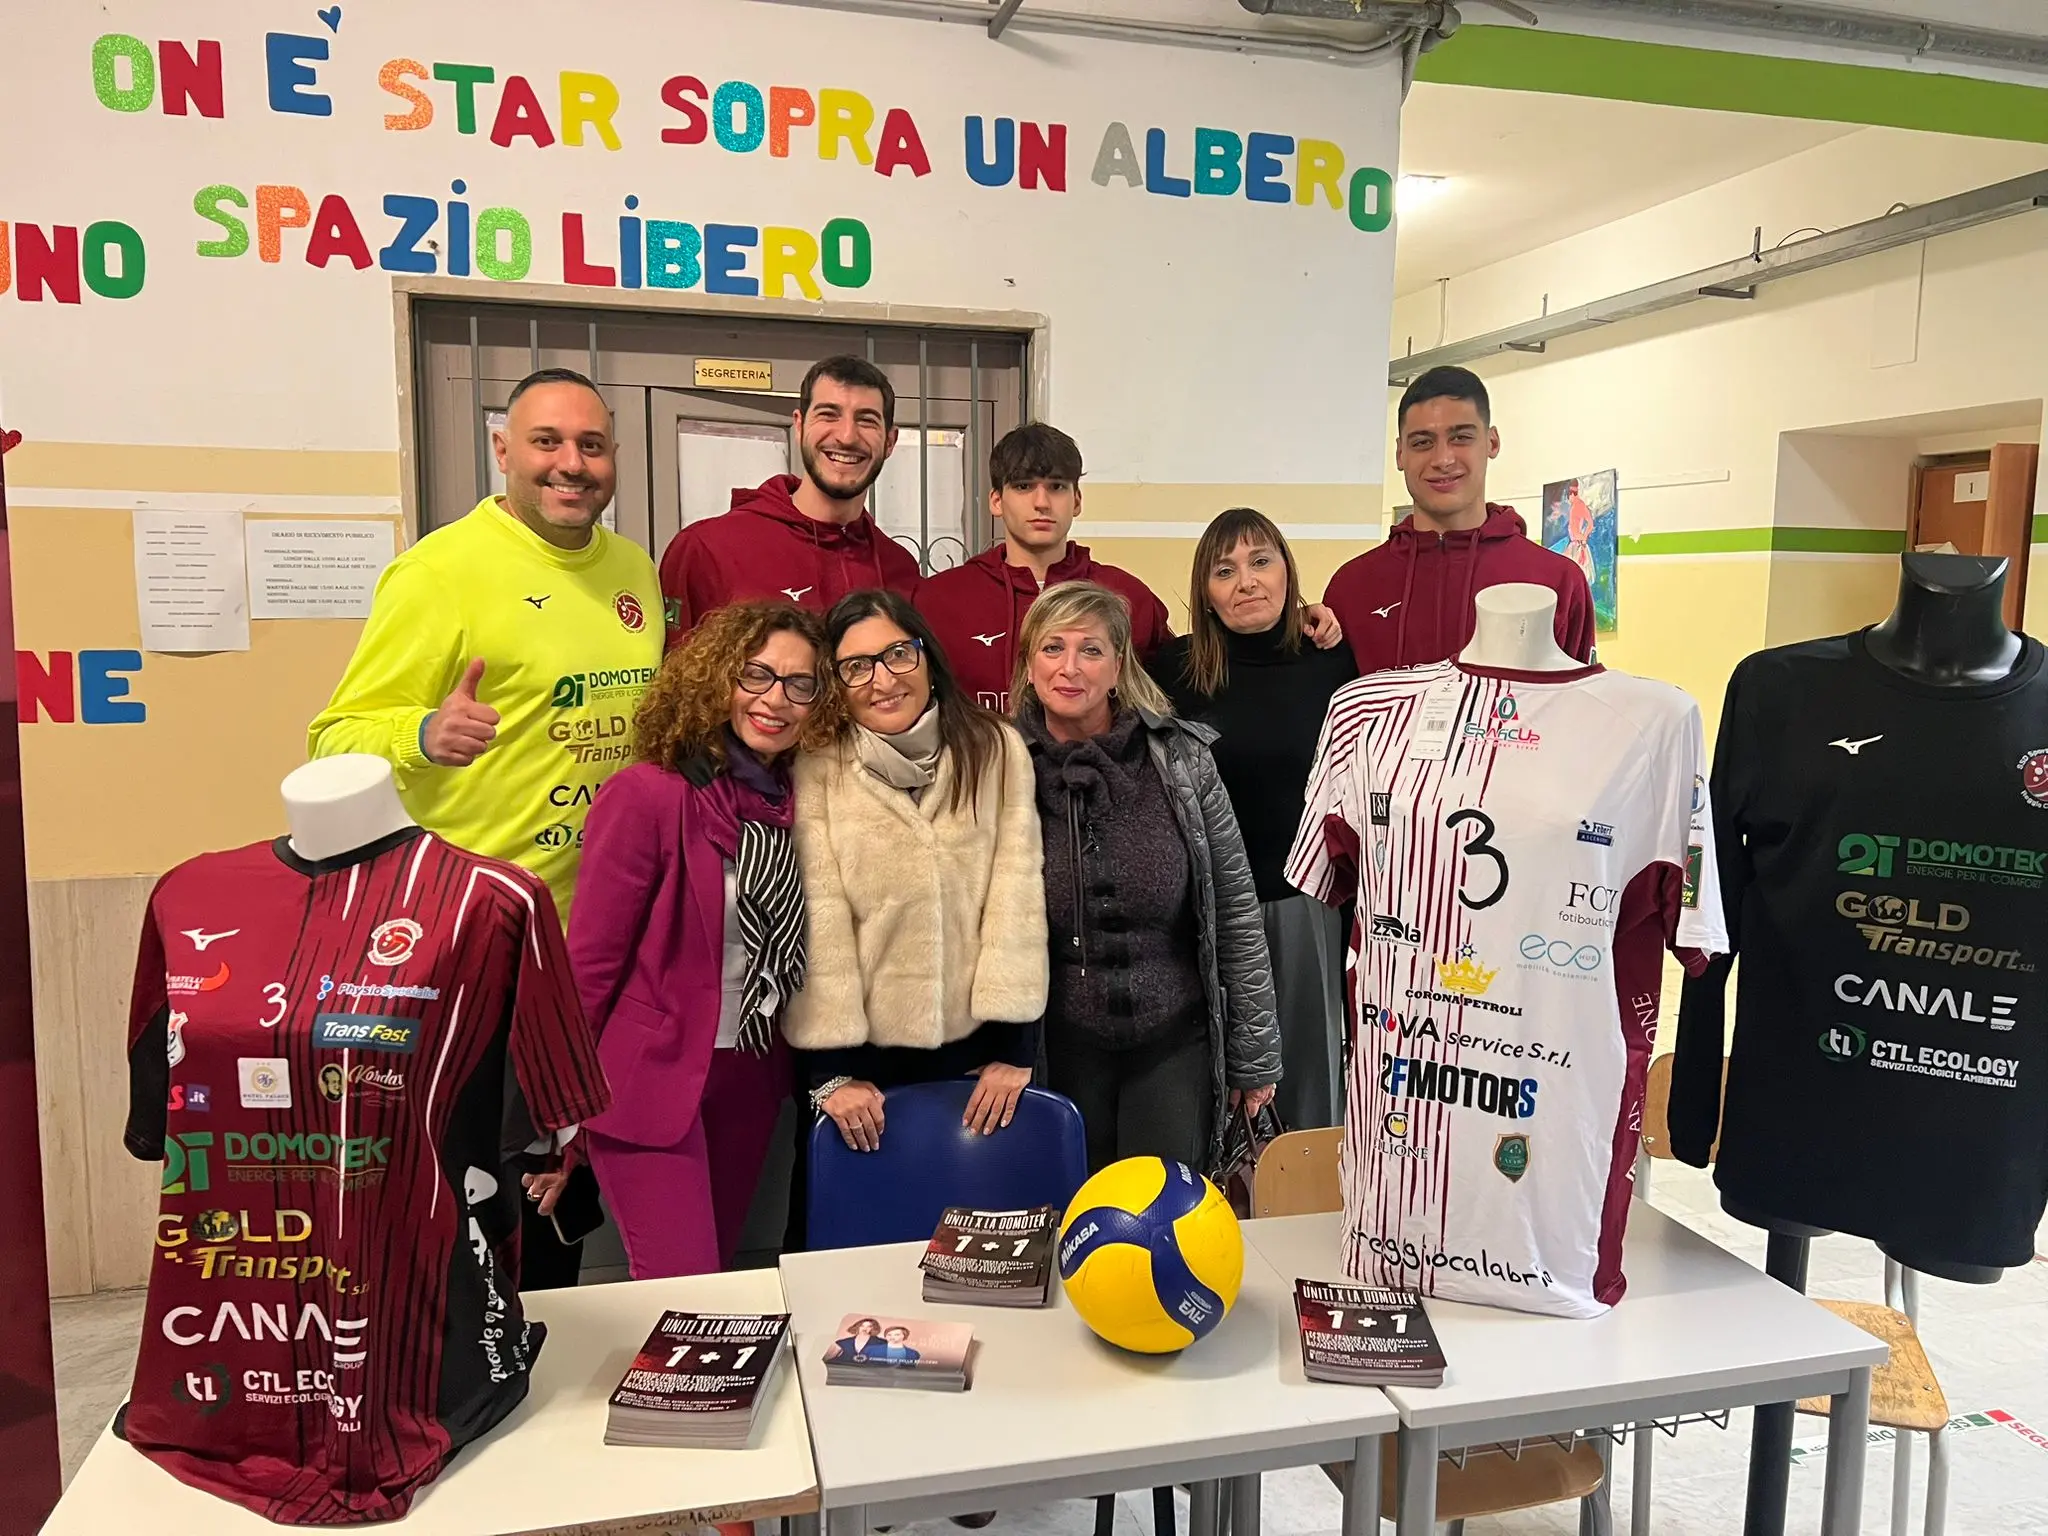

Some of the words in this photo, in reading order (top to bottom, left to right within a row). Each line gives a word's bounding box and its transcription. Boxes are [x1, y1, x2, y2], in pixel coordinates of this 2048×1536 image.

[92, 33, 224, 118] ON
[378, 58, 622, 151] STAR
[661, 75, 931, 180] SOPRA
[965, 115, 1066, 192] UN
[1091, 121, 1391, 233] ALBERO
[193, 179, 531, 281] SPAZIO
[563, 194, 871, 299] LIBERO
[702, 368, 766, 380] SEGRETERIA
[591, 691, 614, 701] ENERGIE
[548, 716, 626, 742] GOLD
[1446, 808, 1509, 910] 3
[1907, 838, 2048, 874] DOMOTEK
[1907, 864, 1953, 879] ENERGIE
[1957, 869, 1977, 881] PER
[1990, 874, 2043, 889] COMFORT
[1836, 891, 1970, 932] GOLD
[1520, 934, 1601, 970] eco
[1856, 923, 2022, 970] Transport
[259, 982, 287, 1028] 3
[1405, 989, 1461, 1005] CORONA
[1463, 997, 1523, 1016] PETROLI
[1834, 973, 2018, 1027] CANALE
[1447, 1031, 1525, 1058] service
[1528, 1043, 1571, 1069] S.r.l.
[1872, 1040, 1914, 1063] CTL
[1918, 1046, 2019, 1078] ECOLOGY
[1870, 1058, 1905, 1071] SERVIZI
[1906, 1064, 1954, 1079] ECOLOGICI
[1955, 1072, 1962, 1081] E
[1962, 1073, 2017, 1088] AMBIENTALI
[228, 1169, 288, 1183] ENERGIE
[291, 1169, 316, 1182] PER
[155, 1208, 312, 1247] GOLD
[944, 1213, 975, 1228] UNITI
[975, 1216, 984, 1228] X
[984, 1217, 996, 1230] LA
[999, 1213, 1046, 1230] DOMOTEK
[955, 1235, 973, 1252] 1
[1012, 1238, 1030, 1257] 1
[1303, 1285, 1334, 1301] UNITI
[1334, 1289, 1344, 1301] X
[1348, 1290, 1362, 1303] LA
[1364, 1290, 1417, 1306] DOMOTEK
[661, 1318, 697, 1335] UNITI
[697, 1320, 708, 1335] X
[707, 1320, 722, 1335] LA
[724, 1320, 783, 1335] DOMOTEK
[1327, 1310, 1344, 1329] 1
[1390, 1314, 1408, 1334] 1
[478, 1327, 510, 1384] Sport
[665, 1345, 691, 1367] 1
[732, 1346, 757, 1369] 1
[243, 1370, 291, 1392] CTL
[246, 1393, 283, 1404] SERVIZI
